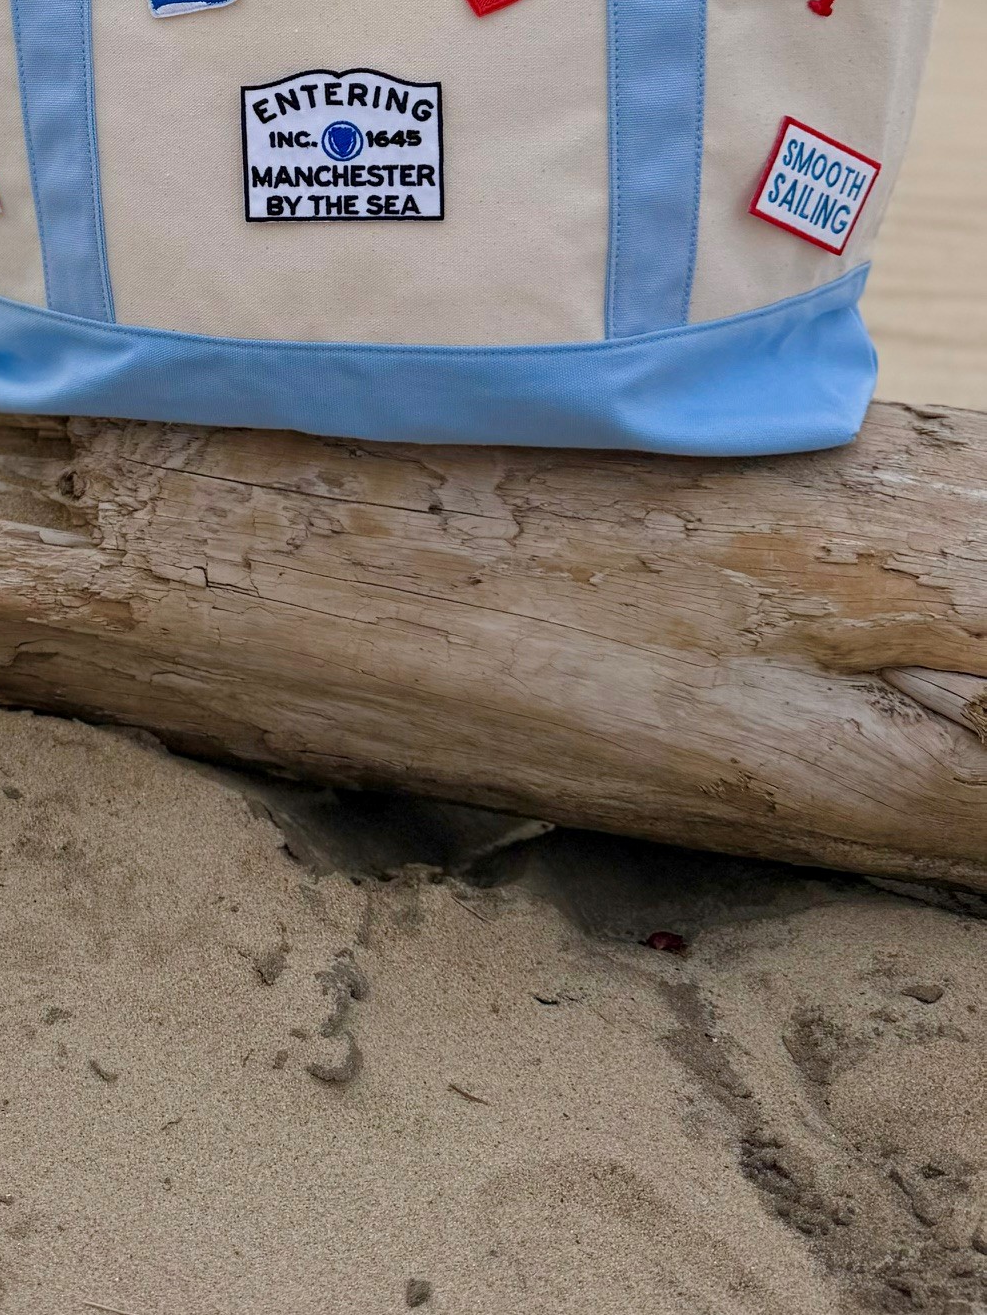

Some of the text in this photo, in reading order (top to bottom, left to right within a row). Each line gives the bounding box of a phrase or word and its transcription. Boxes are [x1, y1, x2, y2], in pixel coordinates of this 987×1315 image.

[252, 82, 435, 124] ENTERING
[268, 129, 423, 148] INC. 1645
[251, 164, 436, 189] MANCHESTER
[782, 138, 867, 202] SMOOTH
[266, 194, 422, 216] BY THE SEA
[767, 172, 851, 235] SAILING
